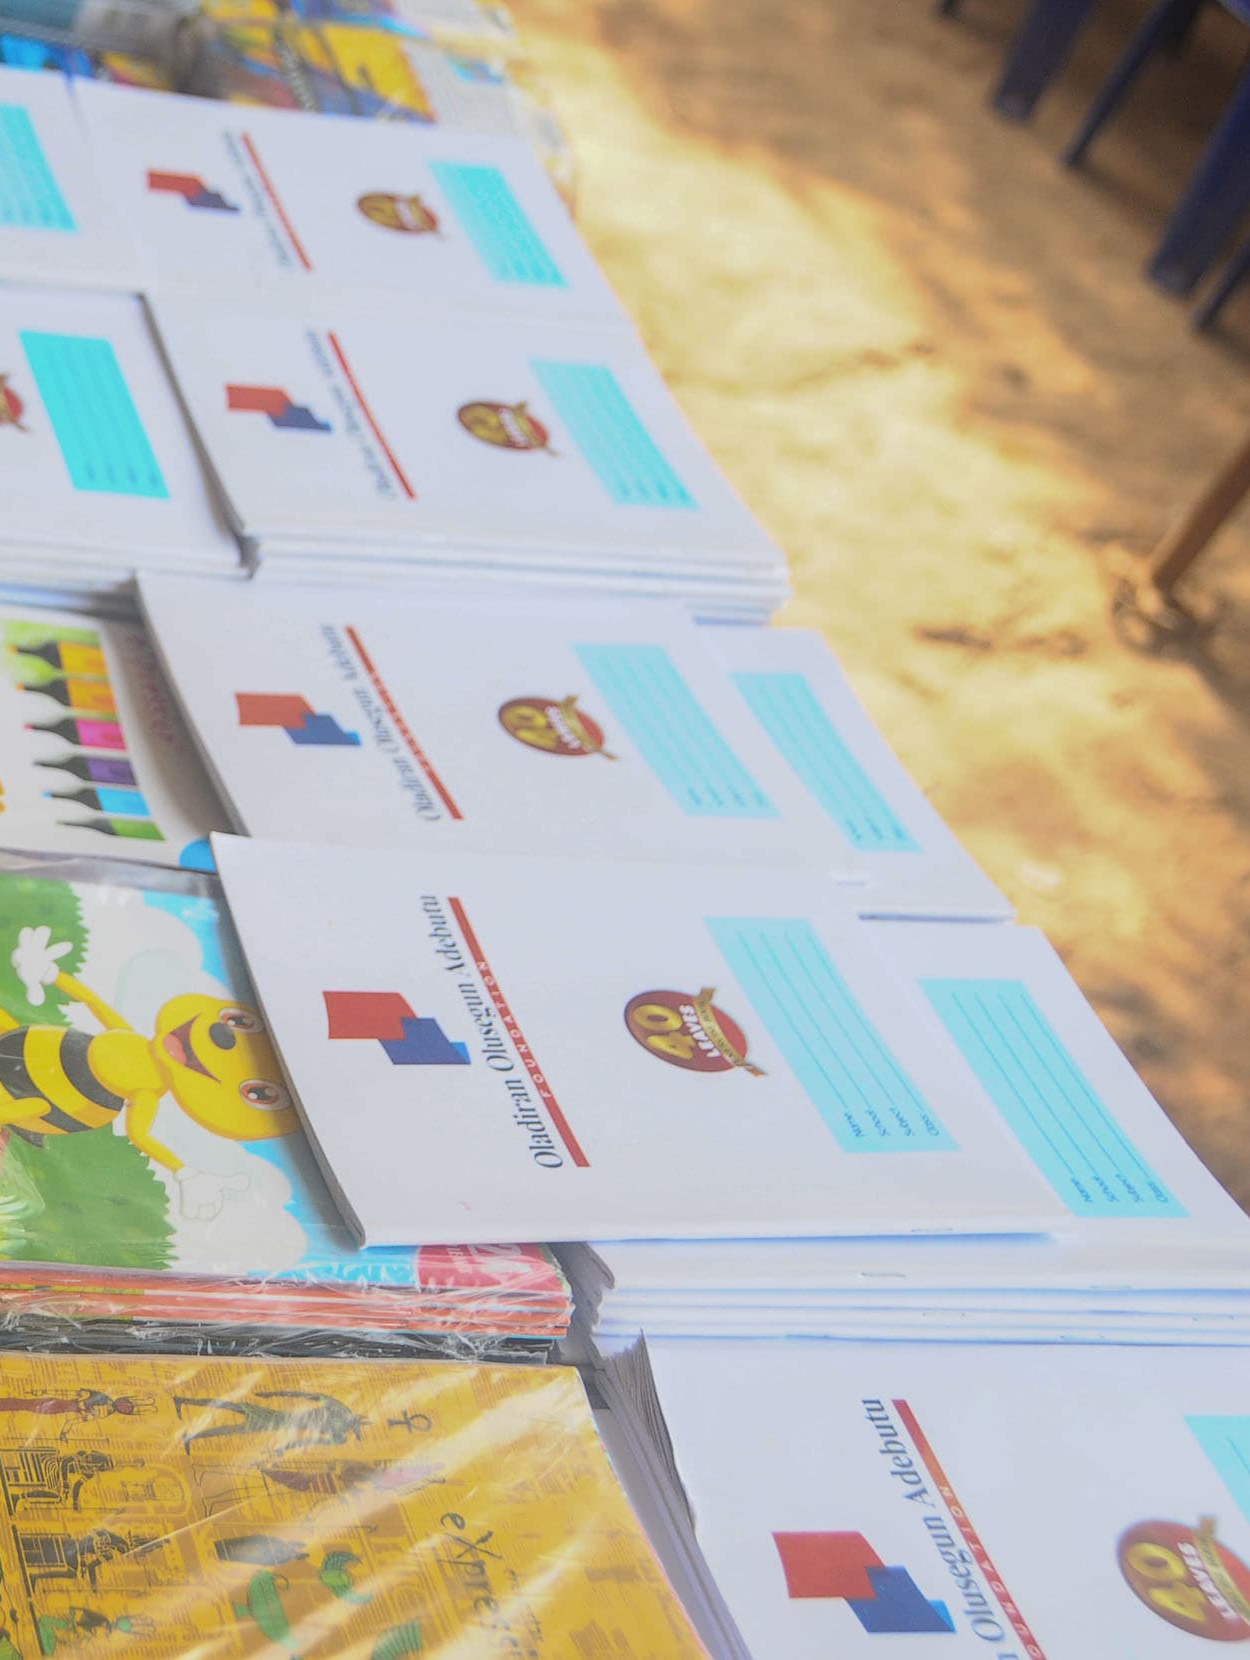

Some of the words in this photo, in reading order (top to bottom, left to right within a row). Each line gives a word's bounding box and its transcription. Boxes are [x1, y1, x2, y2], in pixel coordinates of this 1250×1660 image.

[421, 895, 471, 977] Adebutu
[458, 983, 514, 1072] Olusegun
[477, 961, 552, 1098] FOUNDATION
[633, 1004, 696, 1060] 40
[679, 1005, 721, 1058] LEAVES
[504, 1079, 564, 1168] Oladiran
[861, 1397, 936, 1508] Adebutu
[922, 1515, 1006, 1643] Olusegun
[938, 1485, 1047, 1660] OUNDATION
[1127, 1541, 1207, 1622] 40
